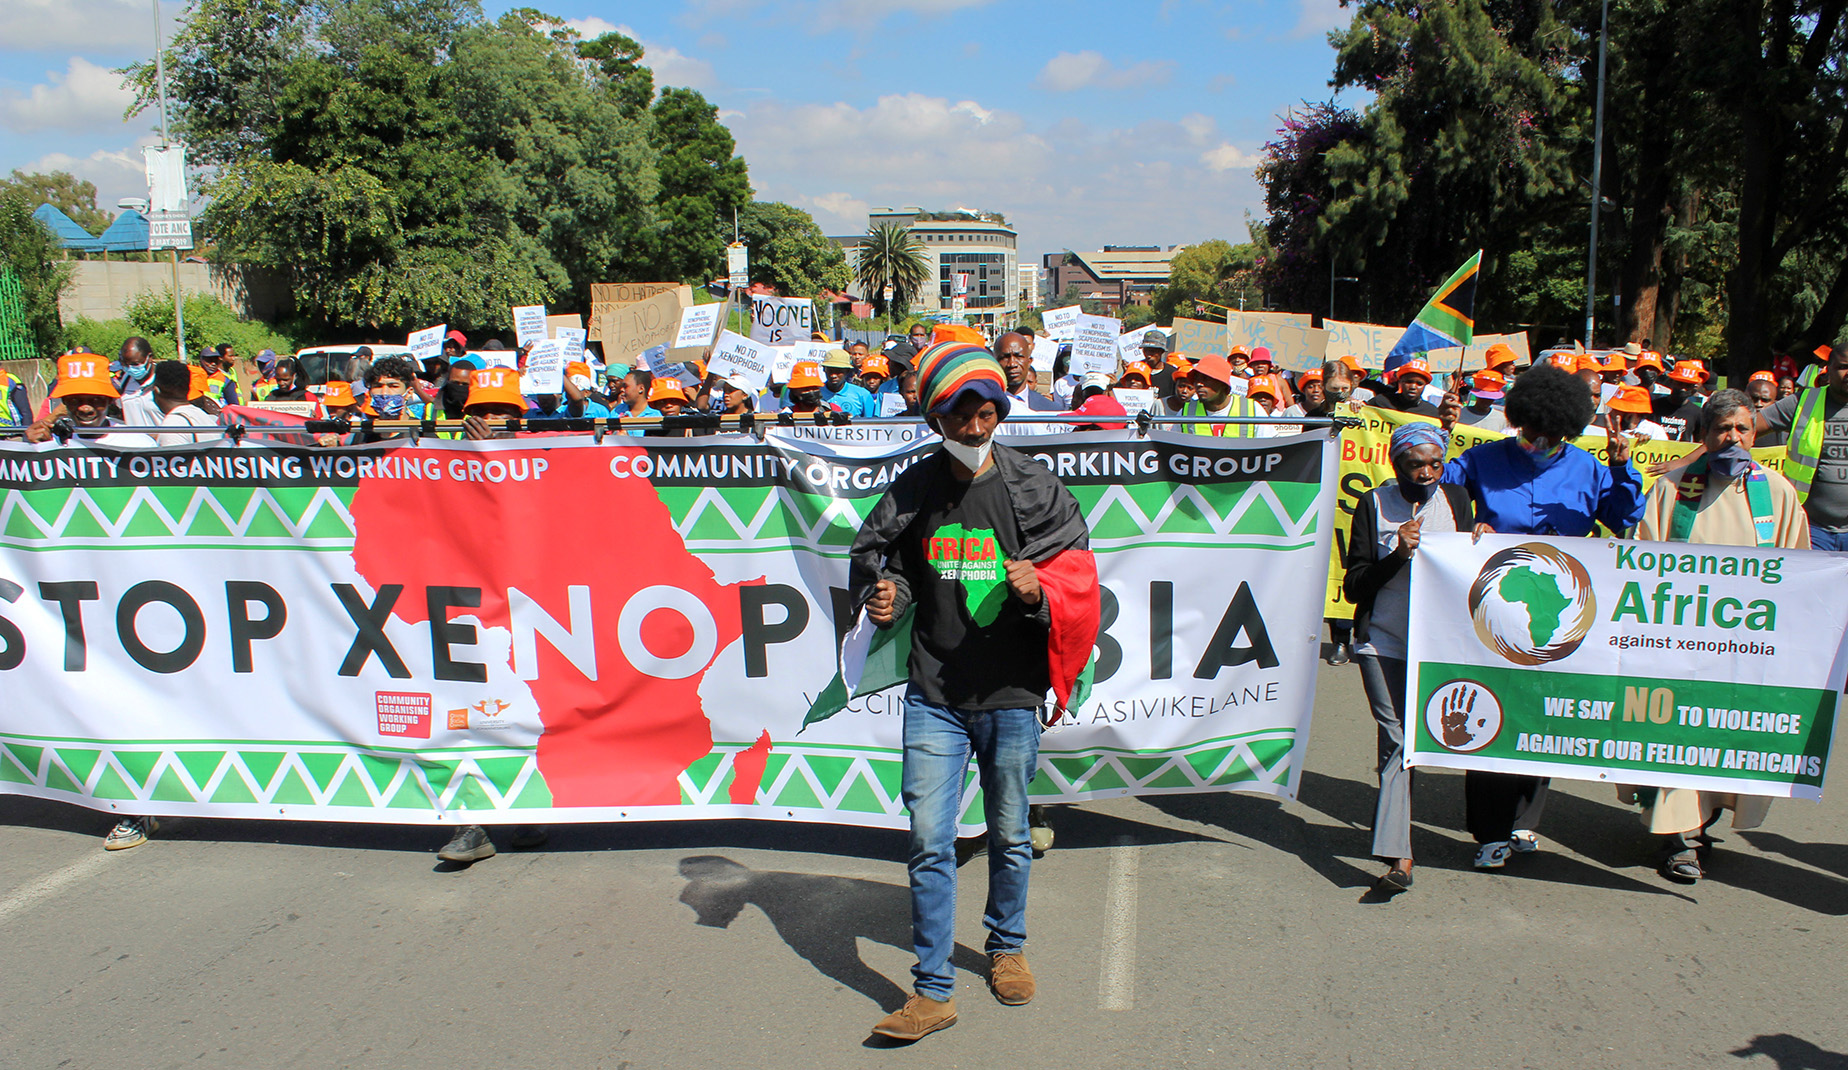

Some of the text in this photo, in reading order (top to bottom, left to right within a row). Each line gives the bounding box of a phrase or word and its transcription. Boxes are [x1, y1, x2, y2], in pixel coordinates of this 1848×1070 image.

[171, 222, 188, 234] ANC
[594, 284, 671, 302] NO TO HATRE
[770, 330, 782, 342] IS
[1083, 330, 1112, 338] XENOPHOBIC
[734, 344, 757, 358] NO TO
[1079, 342, 1107, 351] CAPITALISM
[784, 352, 792, 360] NO
[808, 349, 826, 358] NO TO
[1644, 351, 1656, 360] UJ
[719, 350, 765, 374] XENOPHOBIA
[1412, 360, 1427, 371] UJ
[1558, 356, 1571, 364] UJ
[68, 362, 95, 378] UJ
[804, 367, 818, 376] UJ
[1133, 362, 1146, 371] UJ
[1682, 368, 1696, 378] UJ
[478, 372, 504, 388] UJ
[666, 380, 680, 390] UJ
[1254, 378, 1269, 386] UJ
[327, 386, 339, 396] UJ
[793, 427, 893, 441] UNIVERSITY
[1342, 440, 1388, 465] Buil
[129, 457, 302, 480] ORGANISING
[310, 456, 441, 480] WORKING
[448, 458, 549, 484] GROUP
[610, 454, 800, 480] COMMUNITY
[1026, 450, 1159, 478] RKING
[1168, 452, 1283, 478] GROUP
[922, 537, 997, 561] AFRICA
[962, 561, 997, 569] AGAINST
[1614, 544, 1784, 586] Kopanang
[940, 570, 997, 580] XENPHOBIA
[1610, 580, 1777, 632] Africa
[1608, 634, 1776, 657] against xenophobia
[377, 695, 430, 706] COMMUNITY
[1091, 682, 1280, 724] ASIVIKELANE
[378, 705, 429, 715] ORGANISING
[1544, 686, 1801, 735] WE SAY NO TO VIOLENCE
[379, 714, 419, 724] WORKING
[380, 723, 407, 733] GROUP
[1516, 733, 1821, 778] AGAINST OUR FELLOW AFRICANS
